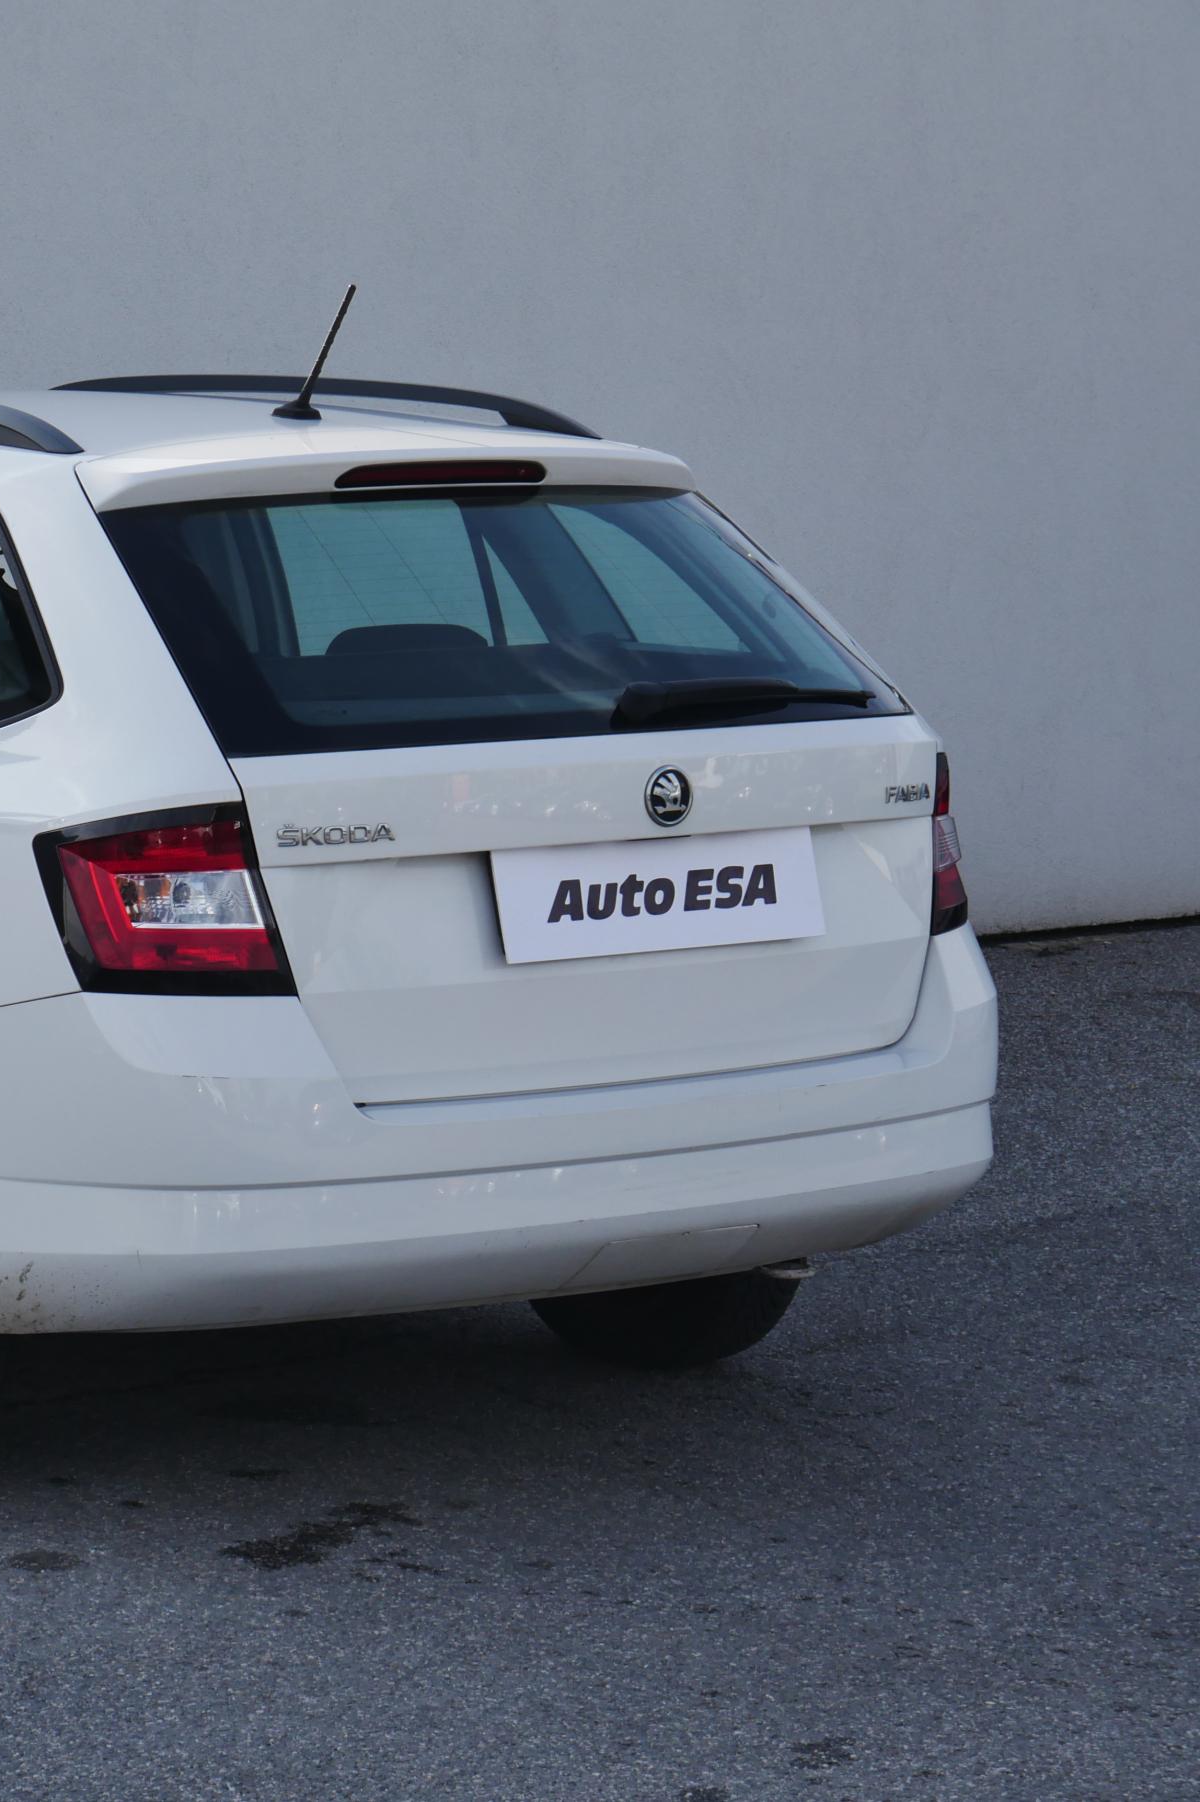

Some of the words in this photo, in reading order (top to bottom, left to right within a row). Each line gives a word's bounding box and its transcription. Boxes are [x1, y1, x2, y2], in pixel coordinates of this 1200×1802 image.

[276, 822, 395, 847] ŠKODA
[547, 873, 675, 923] Auto
[683, 863, 778, 912] ESA
